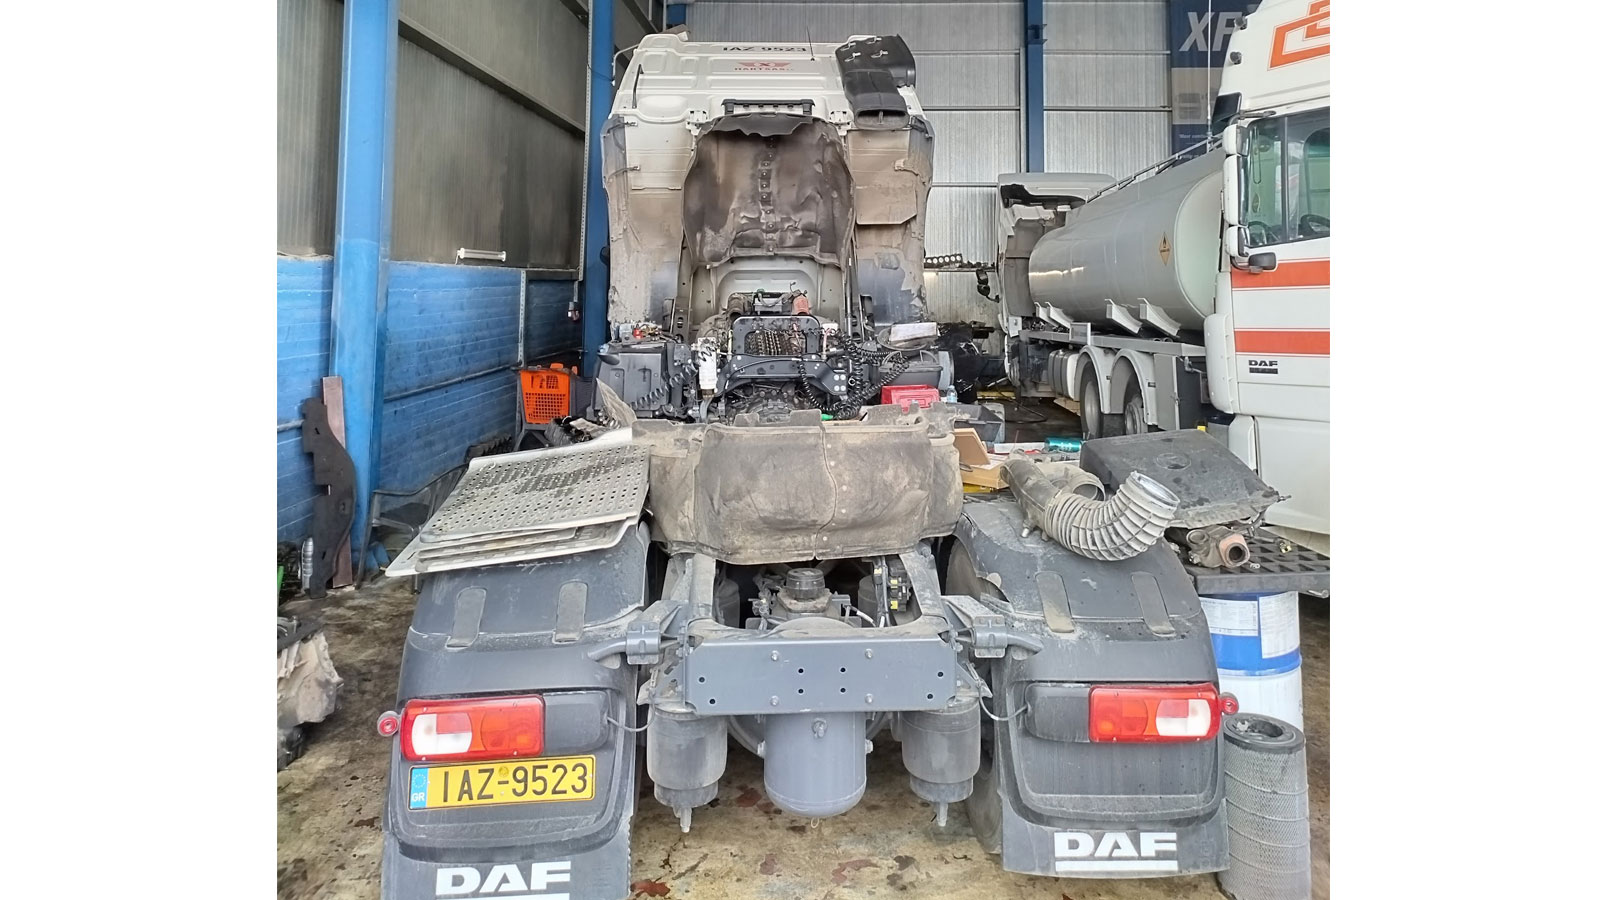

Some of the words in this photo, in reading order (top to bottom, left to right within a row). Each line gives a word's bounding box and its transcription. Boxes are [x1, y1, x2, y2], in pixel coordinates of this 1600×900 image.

[1248, 359, 1278, 367] DAF
[442, 762, 588, 802] IAZ-9523
[412, 792, 425, 801] GR
[1054, 832, 1177, 857] DAF
[435, 860, 572, 896] DAF
